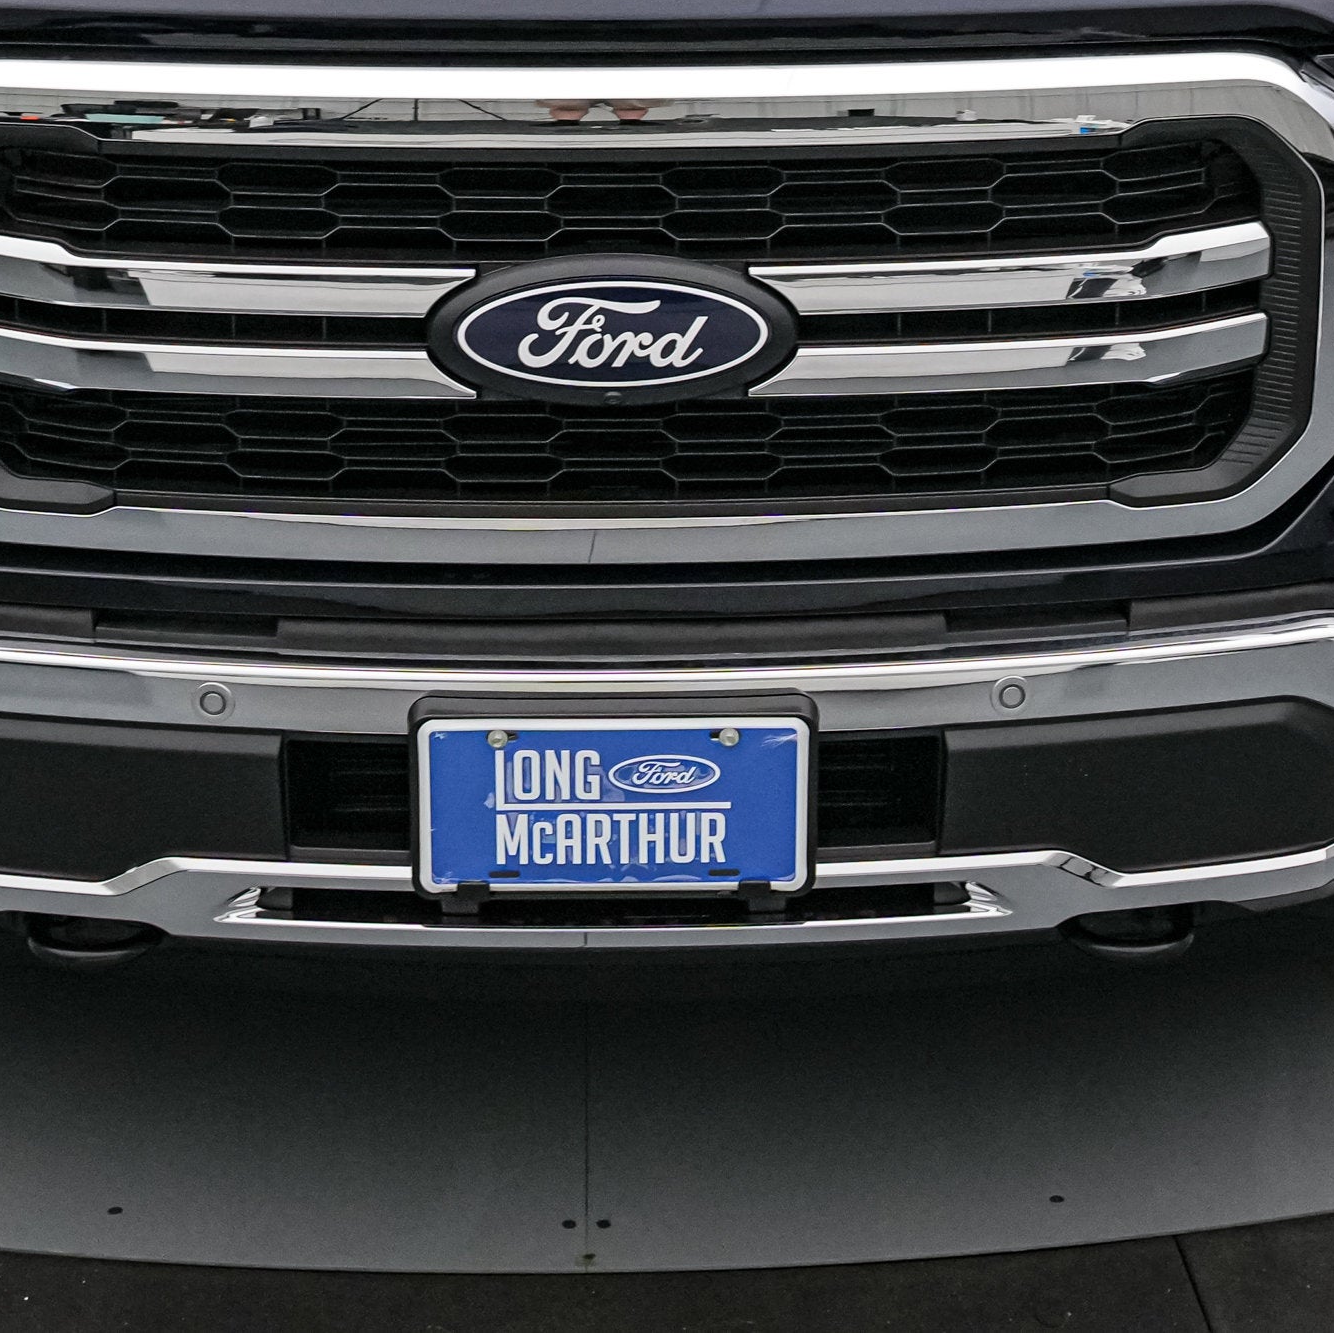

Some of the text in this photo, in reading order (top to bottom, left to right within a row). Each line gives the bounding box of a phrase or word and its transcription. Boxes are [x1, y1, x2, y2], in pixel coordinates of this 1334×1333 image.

[518, 297, 708, 368] Ford
[495, 749, 695, 810] LONG Ford
